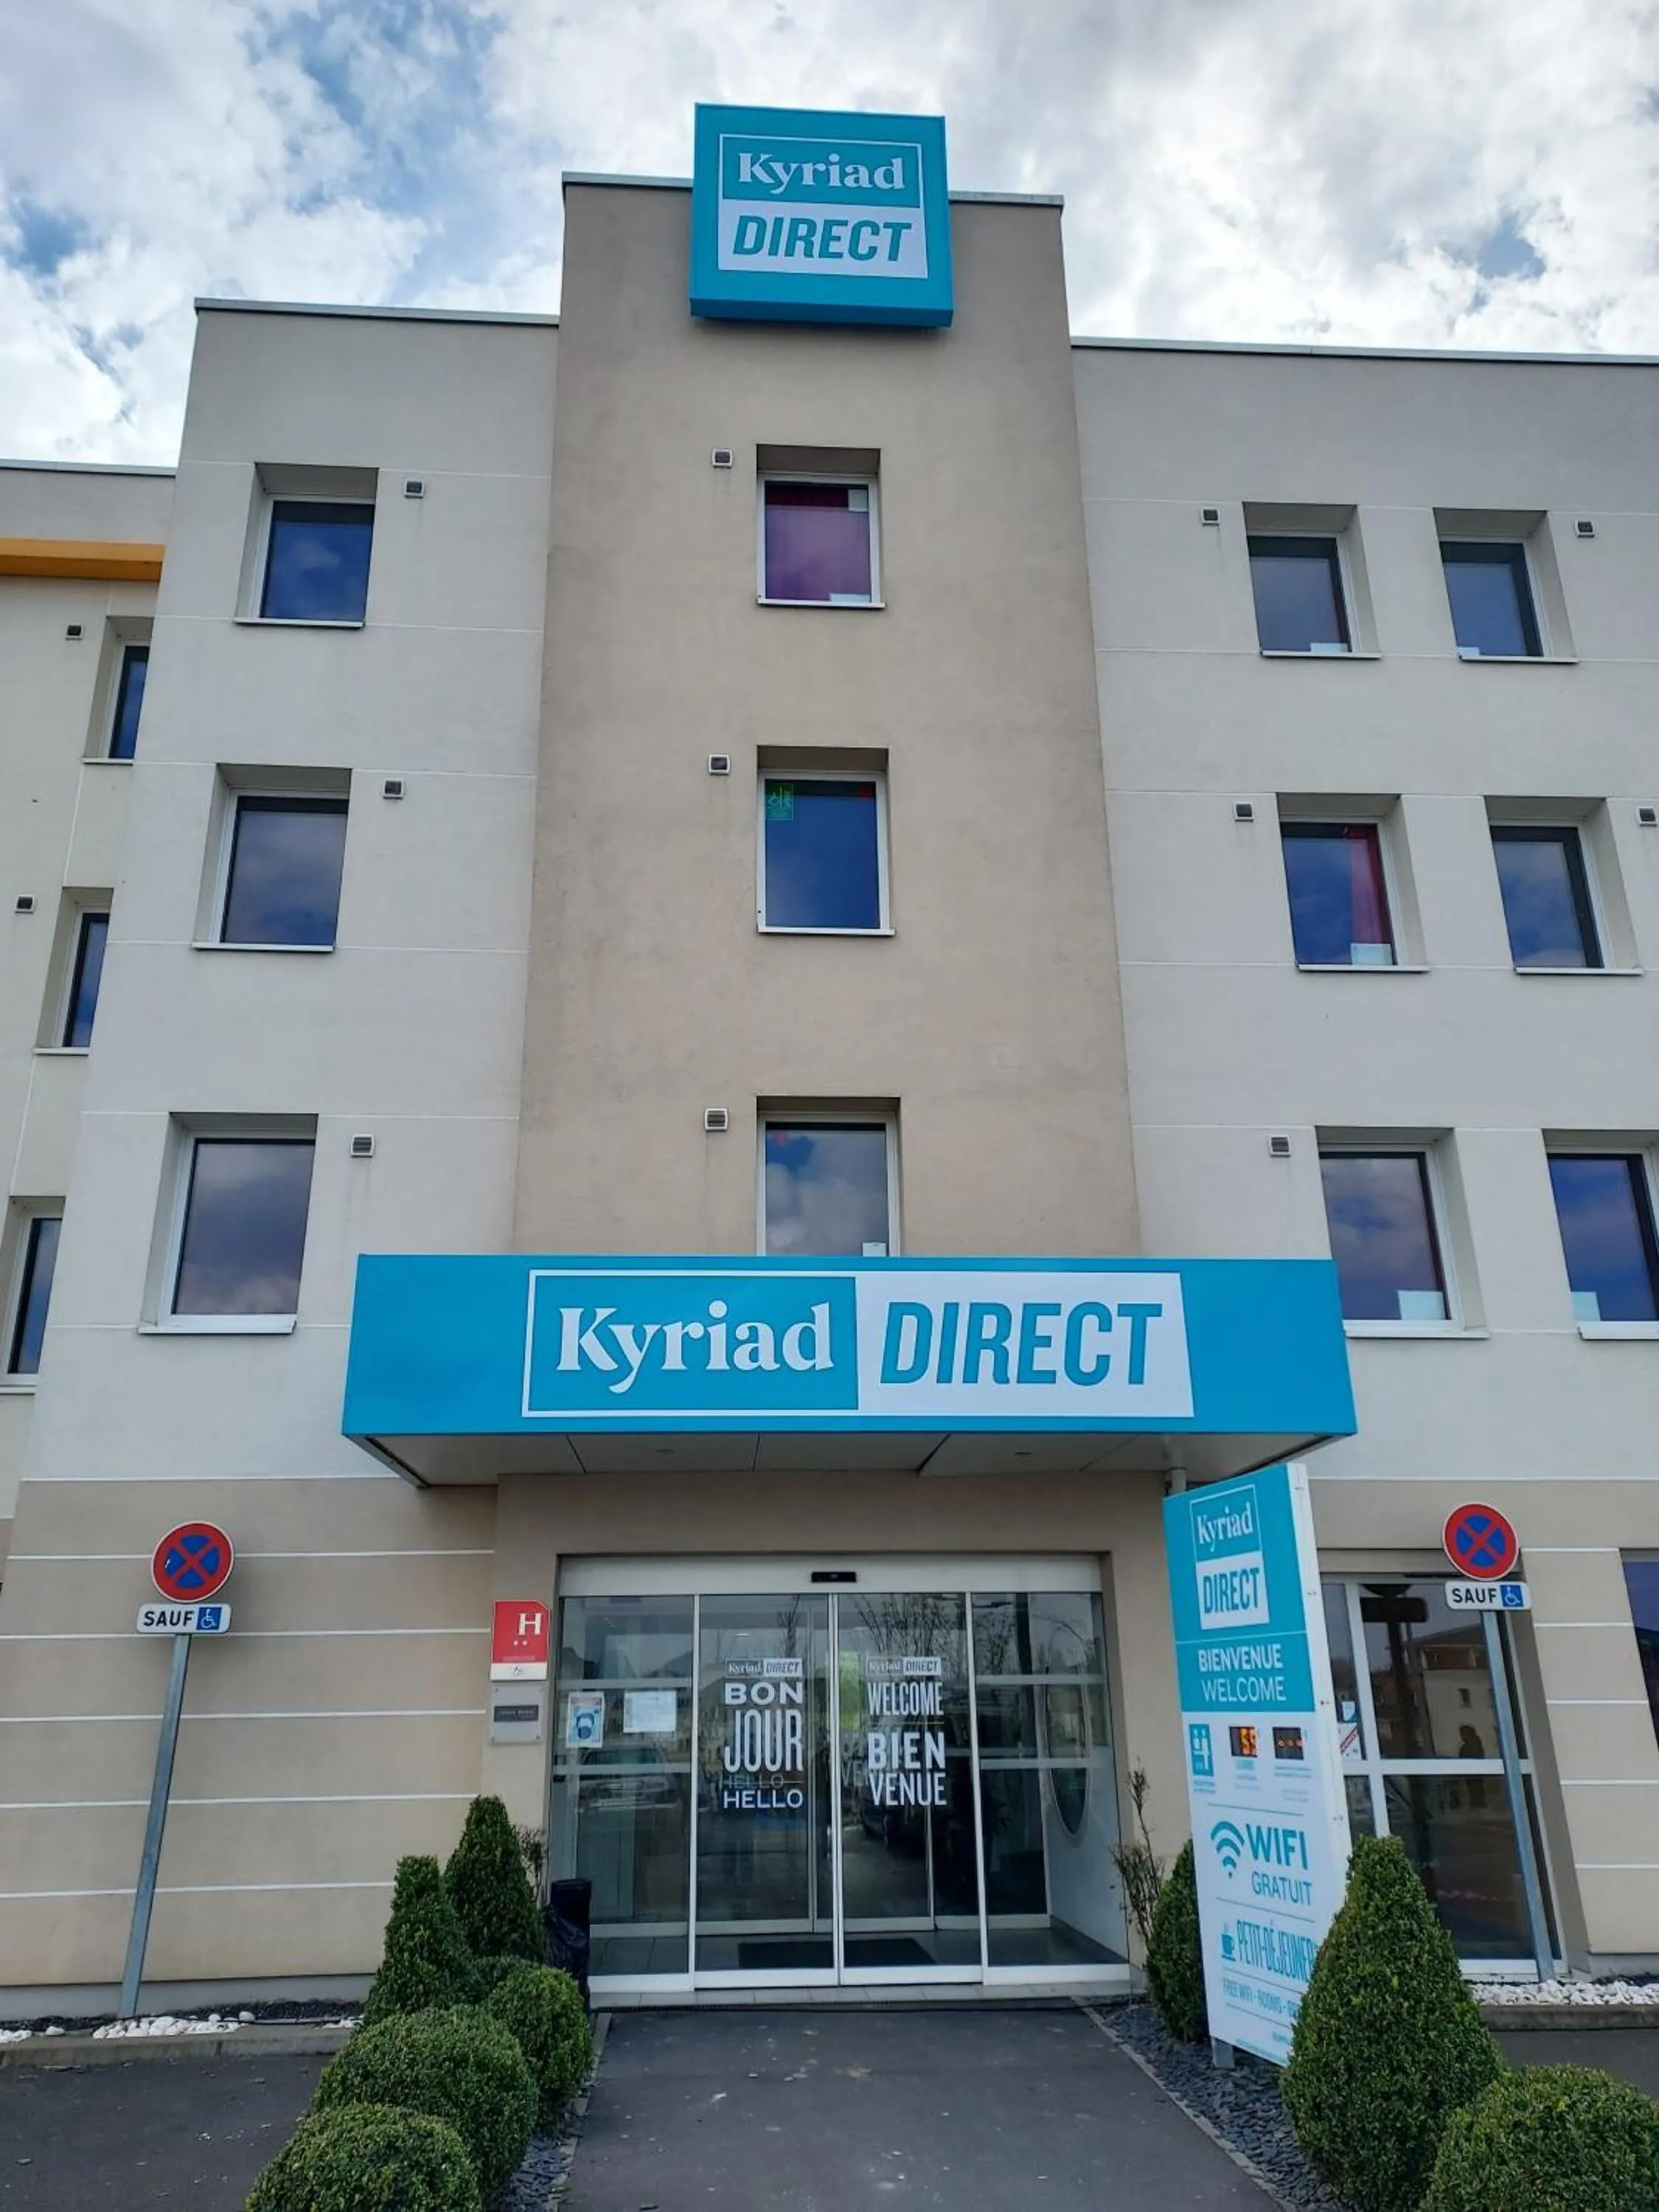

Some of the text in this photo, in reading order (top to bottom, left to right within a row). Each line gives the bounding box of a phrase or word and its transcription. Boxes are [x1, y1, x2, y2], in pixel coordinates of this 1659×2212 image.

[738, 153, 905, 195] Kyriad
[733, 215, 912, 262] DIRECT
[555, 1300, 1164, 1394] Kyriad DIRECT
[1196, 1501, 1253, 1553] Kyriad
[1203, 1567, 1260, 1614] DIRECT
[1452, 1588, 1497, 1604] SAUF
[143, 1610, 195, 1627] SAUF
[518, 1613, 543, 1636] H
[765, 1660, 800, 1674] DIRECT
[905, 1658, 939, 1672] DIRECT
[1197, 1644, 1283, 1672] BIENVENUE
[725, 1682, 803, 1705] BON
[868, 1682, 944, 1716] WELCOME
[1200, 1676, 1286, 1703] WELCOME
[723, 1708, 803, 1772] JOUR
[868, 1732, 946, 1770] BIEN
[723, 1788, 803, 1809] HELLO
[869, 1772, 947, 1806] VENUE
[1245, 1823, 1309, 1871] WIFI
[1251, 1871, 1313, 1906] GRATUIT
